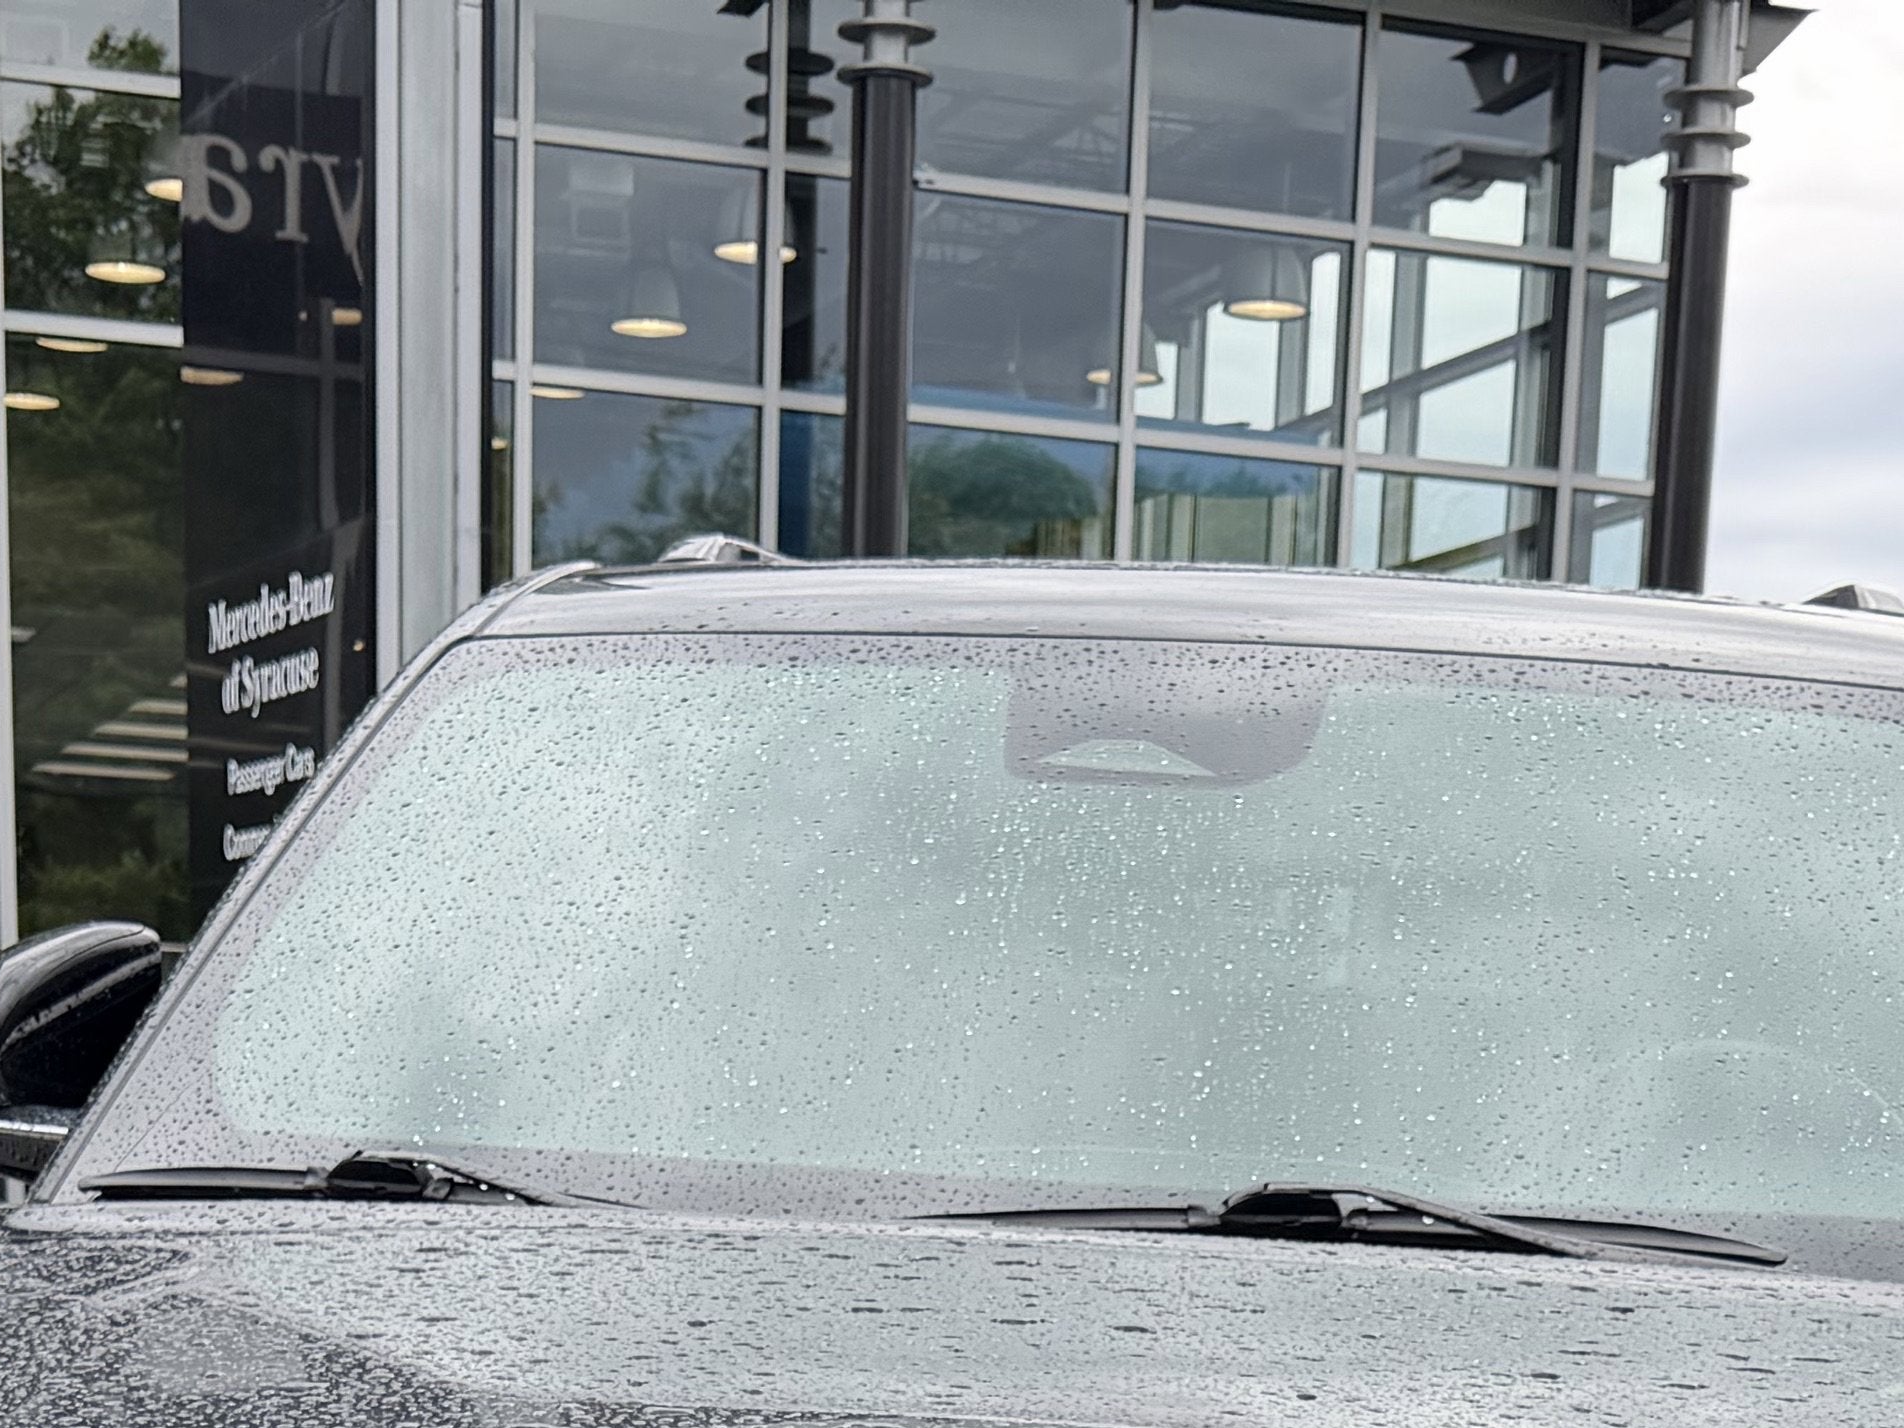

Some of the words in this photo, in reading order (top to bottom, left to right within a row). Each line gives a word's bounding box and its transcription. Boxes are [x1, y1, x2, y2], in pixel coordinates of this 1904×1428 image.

[208, 571, 335, 654] Mercedes-Benz
[221, 658, 241, 714] of
[241, 647, 319, 718] Syracuse
